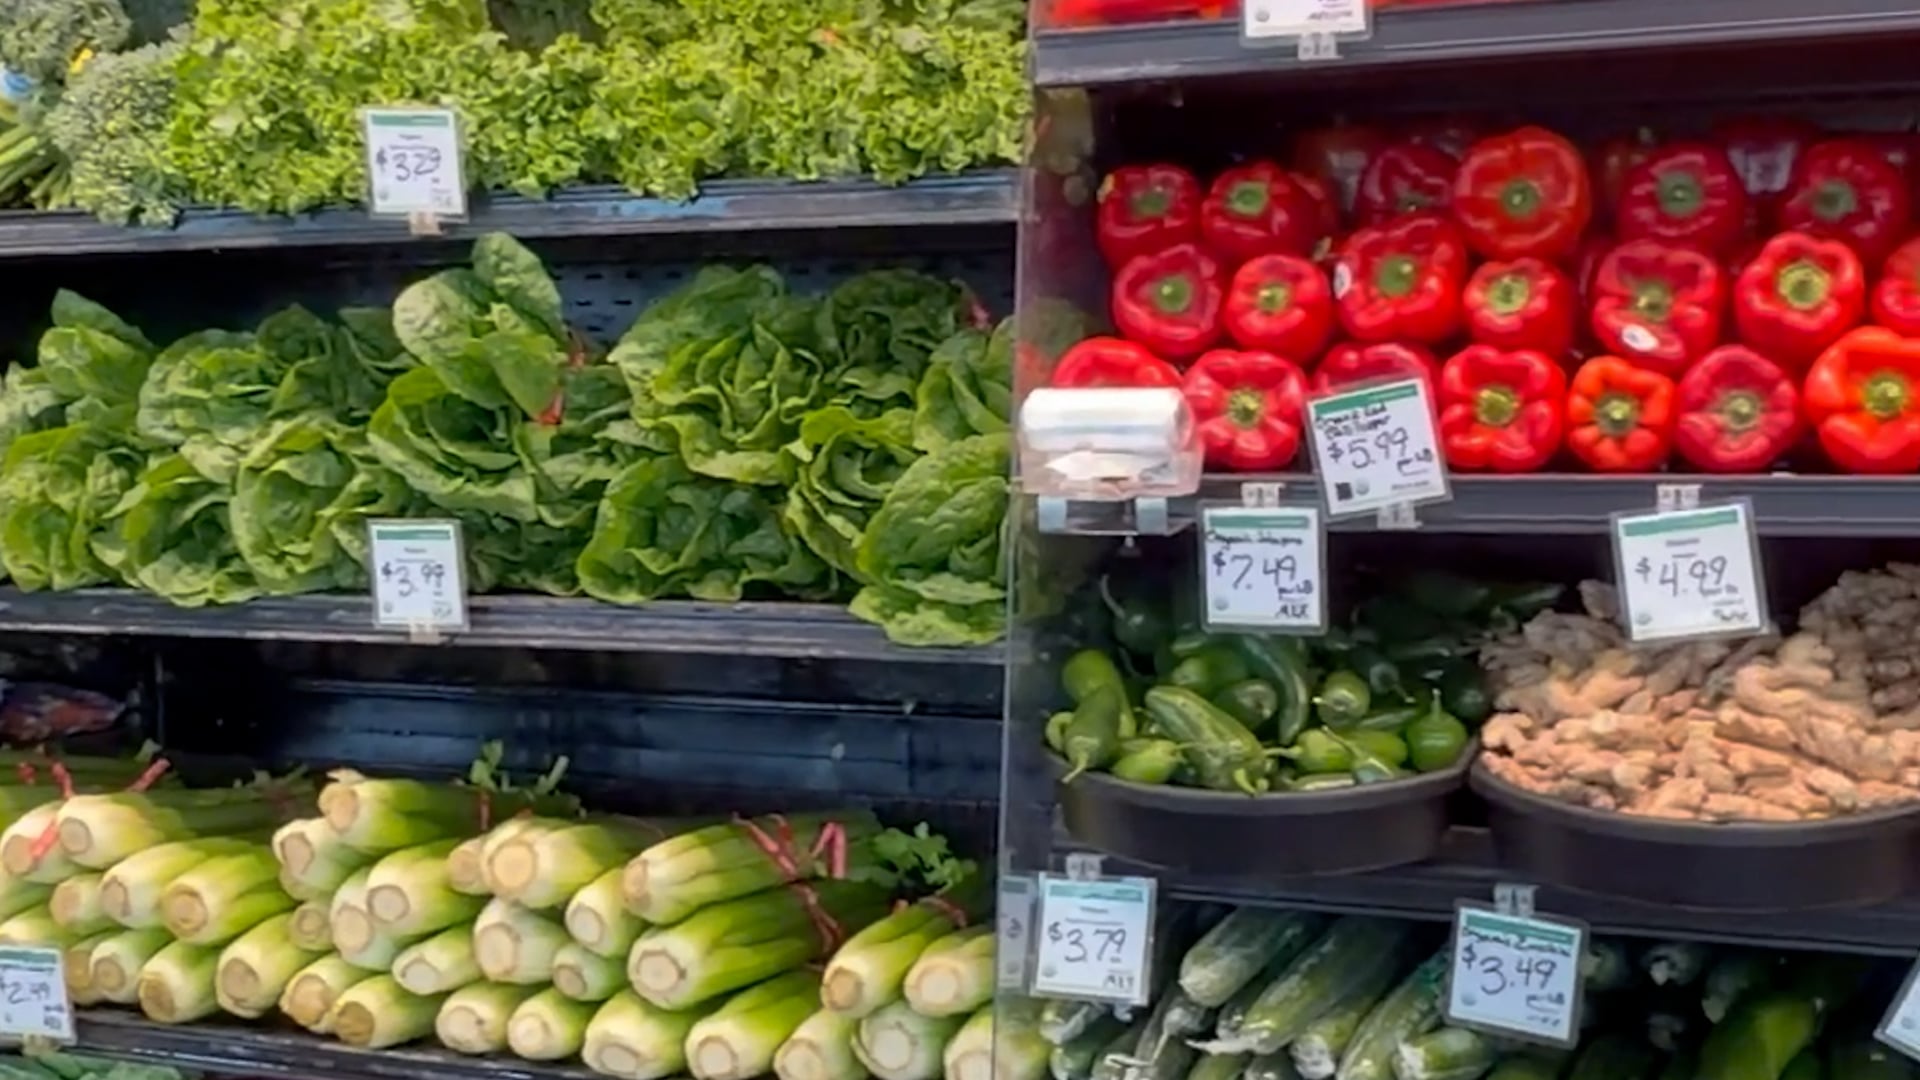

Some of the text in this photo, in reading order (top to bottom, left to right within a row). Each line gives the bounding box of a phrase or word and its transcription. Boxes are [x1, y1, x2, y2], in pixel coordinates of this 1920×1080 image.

[1327, 427, 1408, 470] $5.99
[382, 562, 444, 597] $3.99
[1212, 551, 1297, 591] $7.49
[1634, 555, 1728, 598] $4.99
[1461, 943, 1557, 996] $3.49
